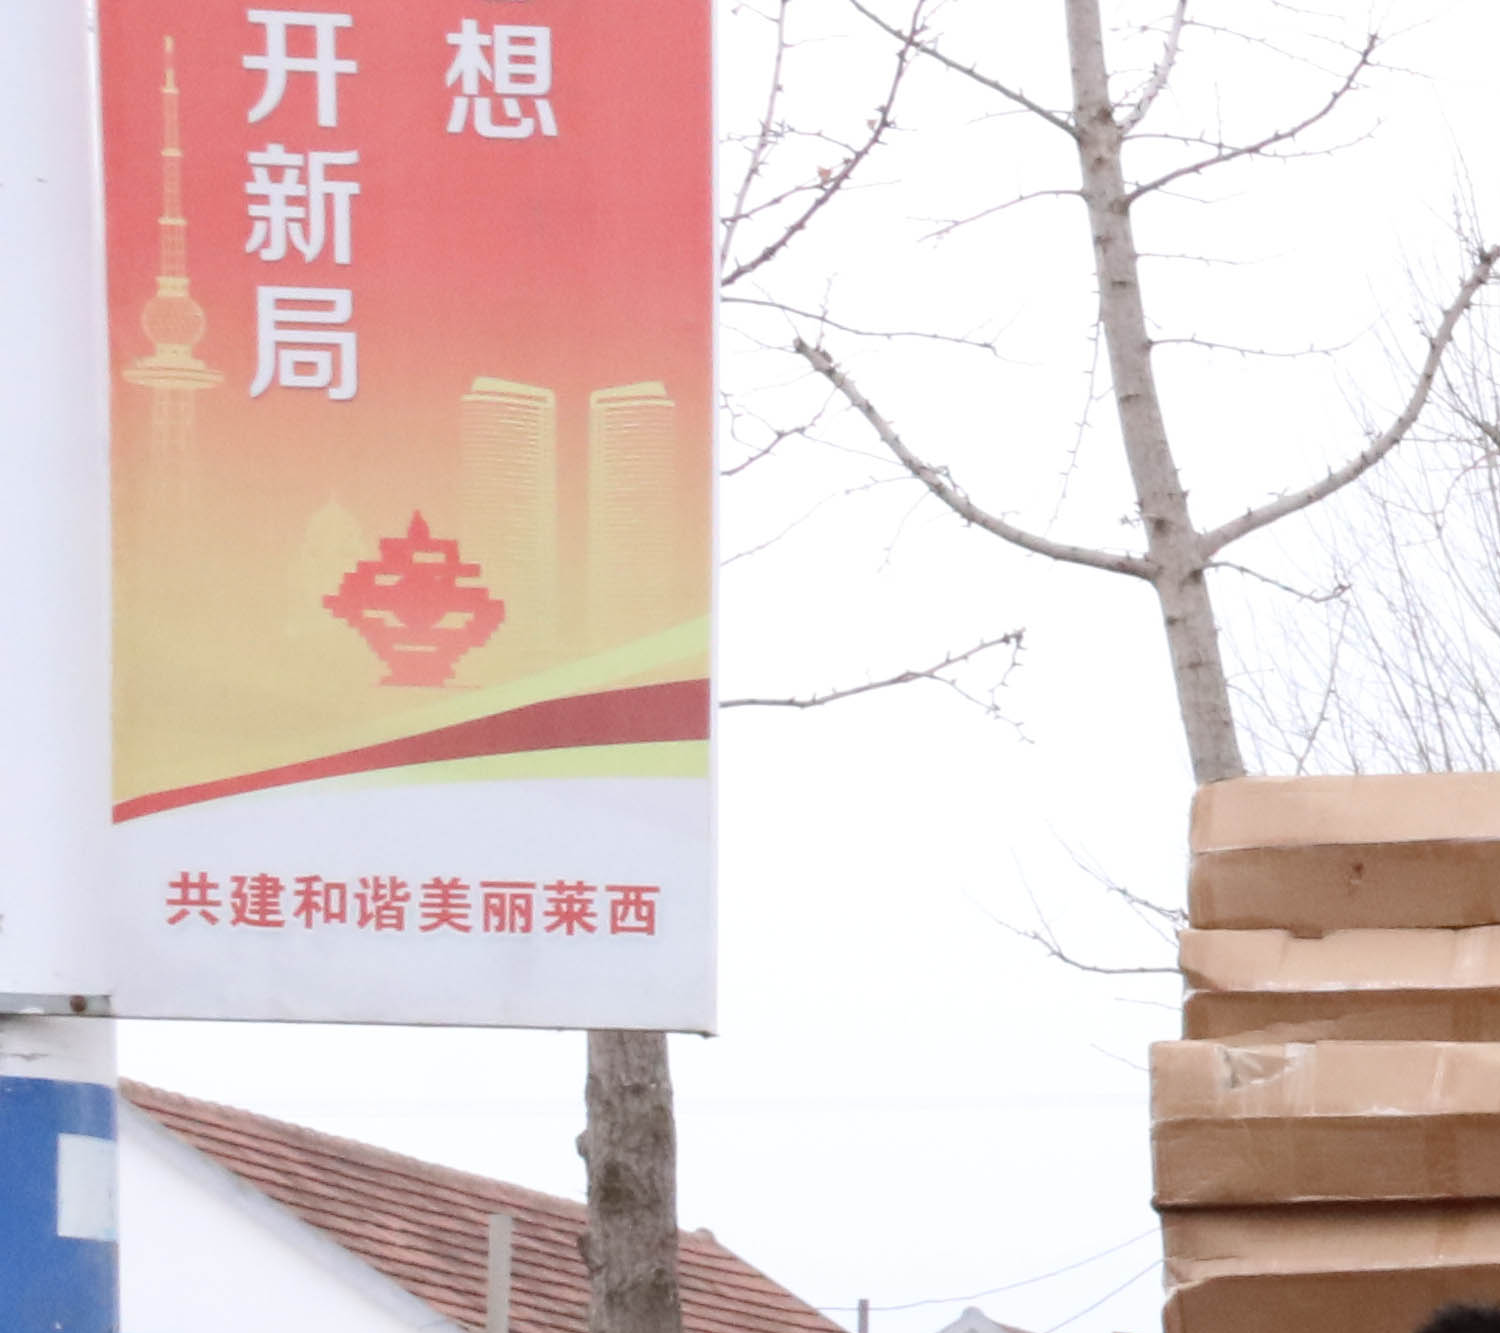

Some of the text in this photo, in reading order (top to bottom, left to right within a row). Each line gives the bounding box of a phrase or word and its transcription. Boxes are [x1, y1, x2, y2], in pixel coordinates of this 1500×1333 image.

[242, 8, 360, 401] 开新局
[166, 870, 661, 936] 共建和谐美丽莱西
